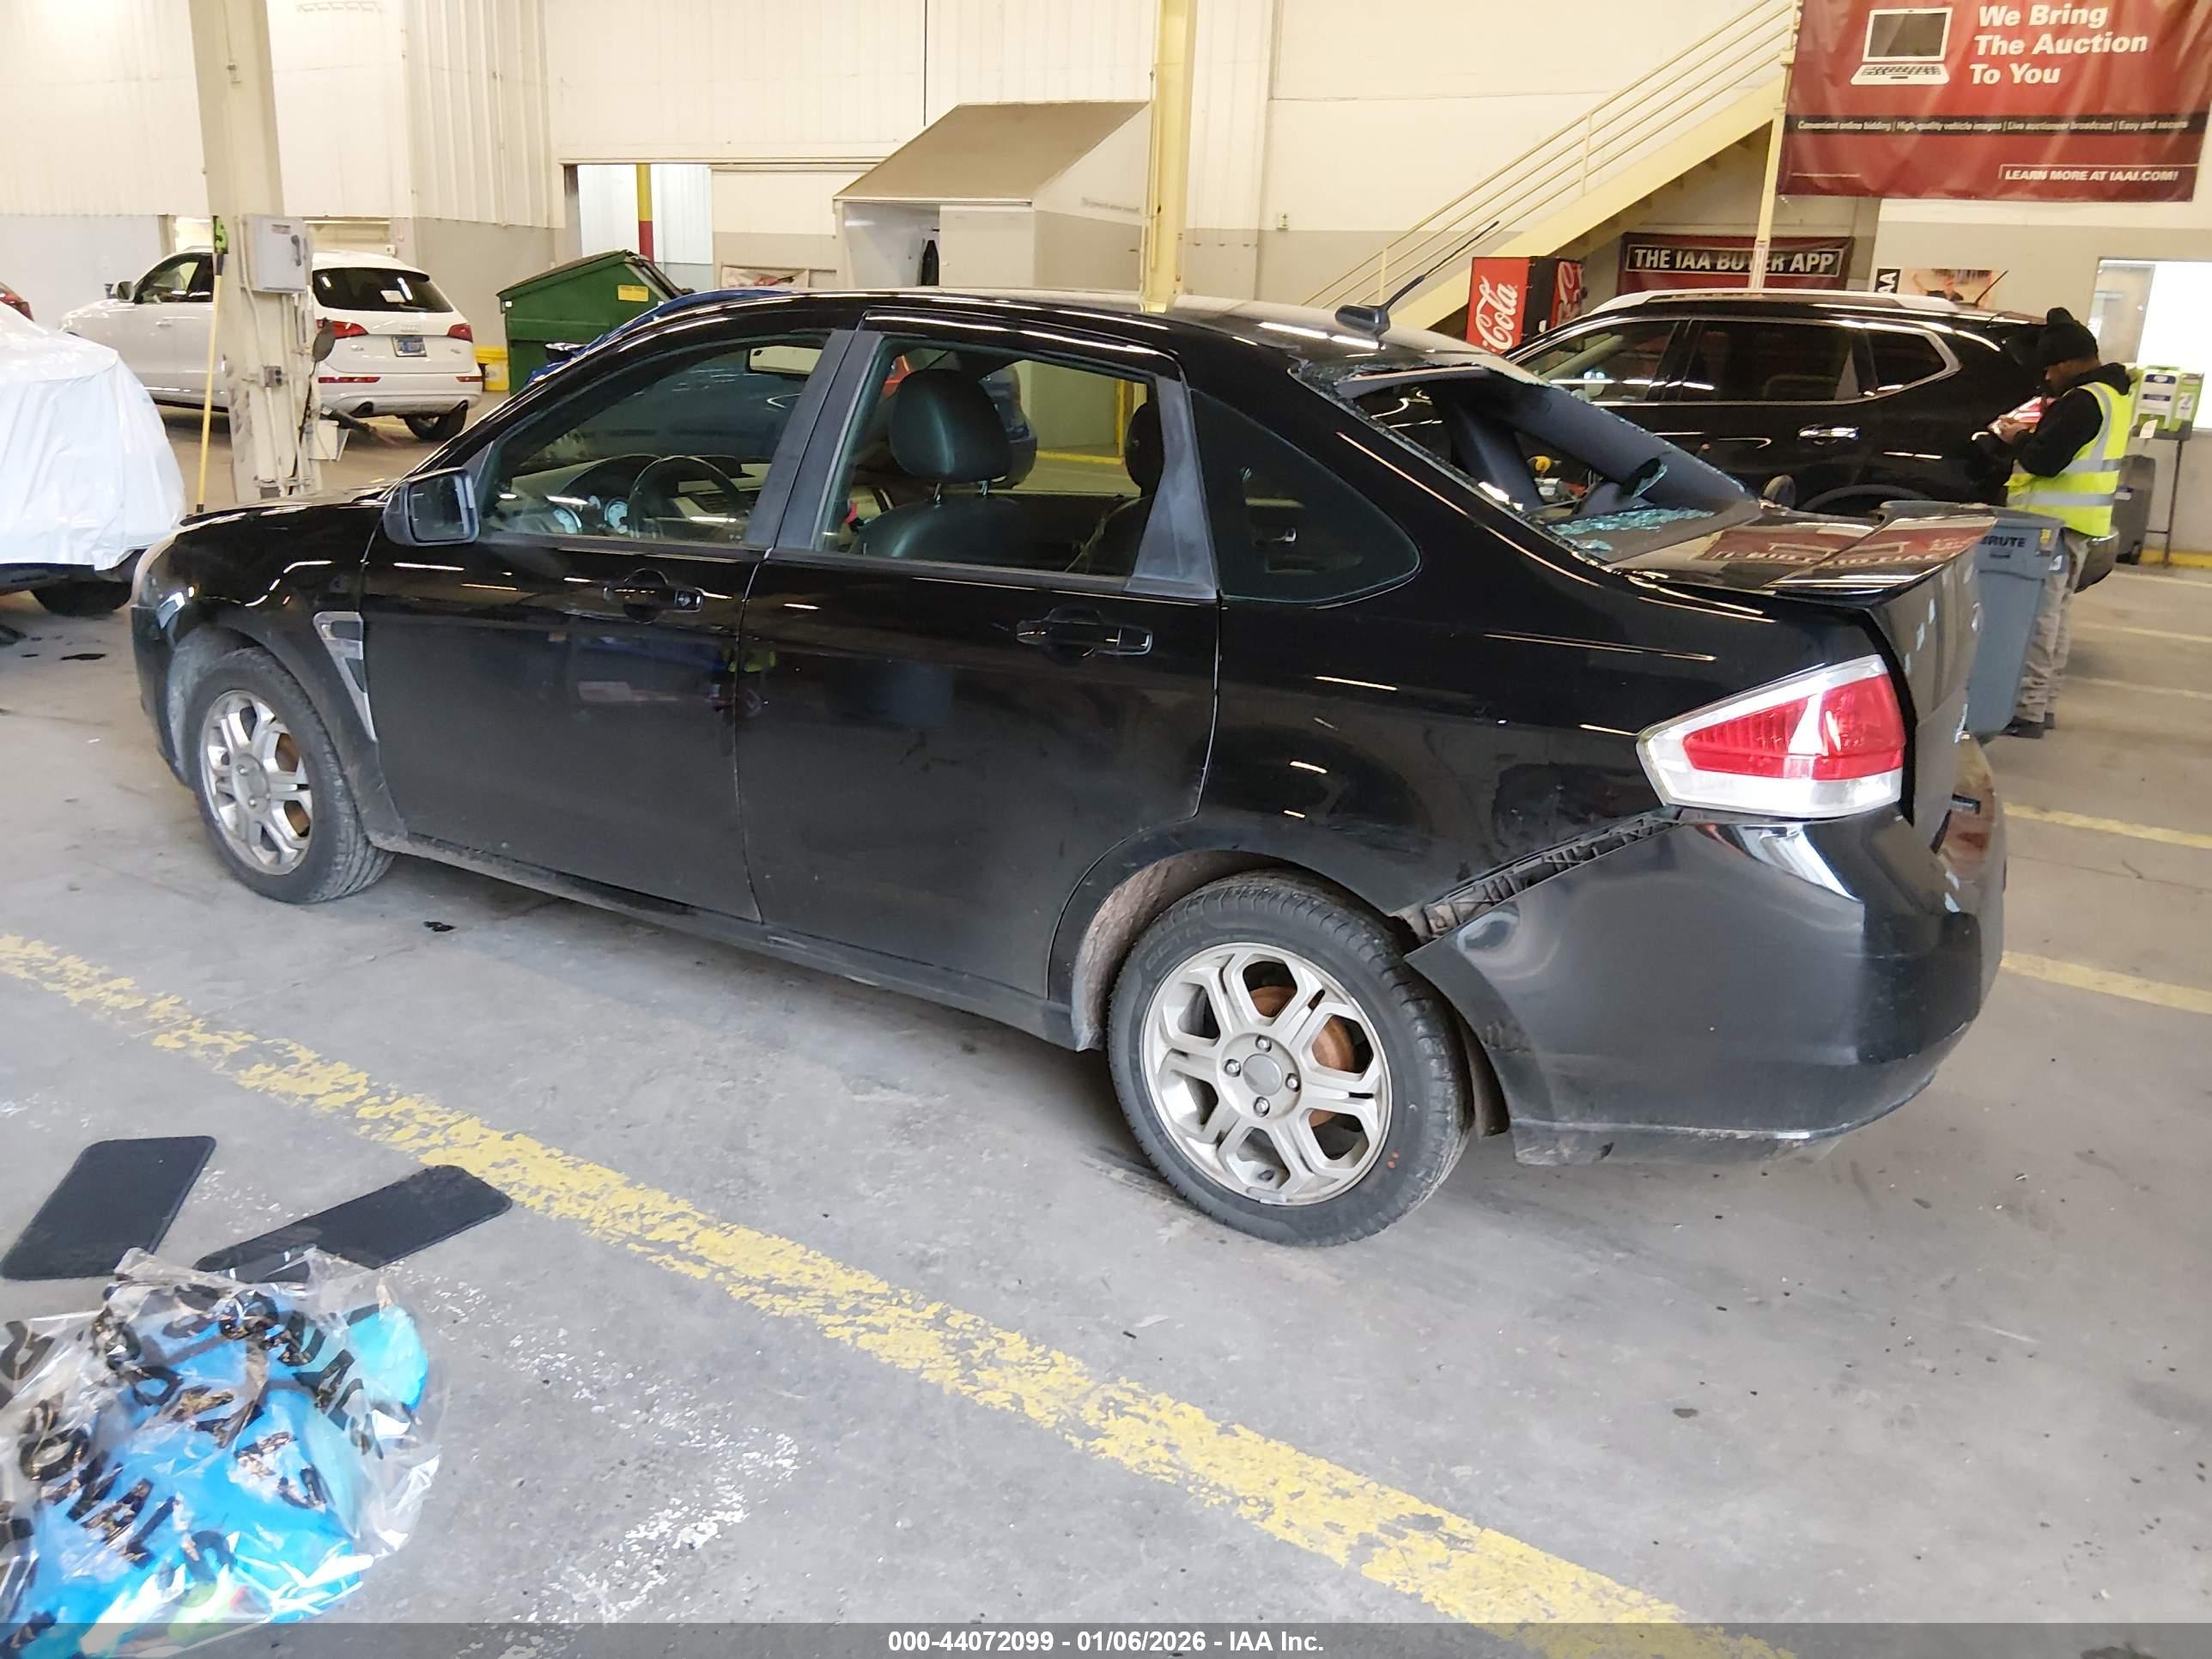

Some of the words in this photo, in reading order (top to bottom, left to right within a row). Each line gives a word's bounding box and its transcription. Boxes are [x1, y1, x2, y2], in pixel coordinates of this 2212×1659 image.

[1978, 5, 2021, 27] We
[2028, 3, 2109, 29] Bring
[1973, 34, 2026, 56] The
[2031, 32, 2148, 55] Auction
[1969, 64, 2002, 85] To
[2008, 63, 2061, 84] You
[2004, 169, 2047, 180] LEARN
[2049, 170, 2088, 180] MORE
[2088, 170, 2109, 181] AT
[2109, 170, 2179, 182] IAAI.COM!
[1633, 248, 1672, 269] THE
[1675, 250, 1711, 270] IAA
[1717, 251, 1785, 272] BUR
[1789, 252, 1836, 273] APP
